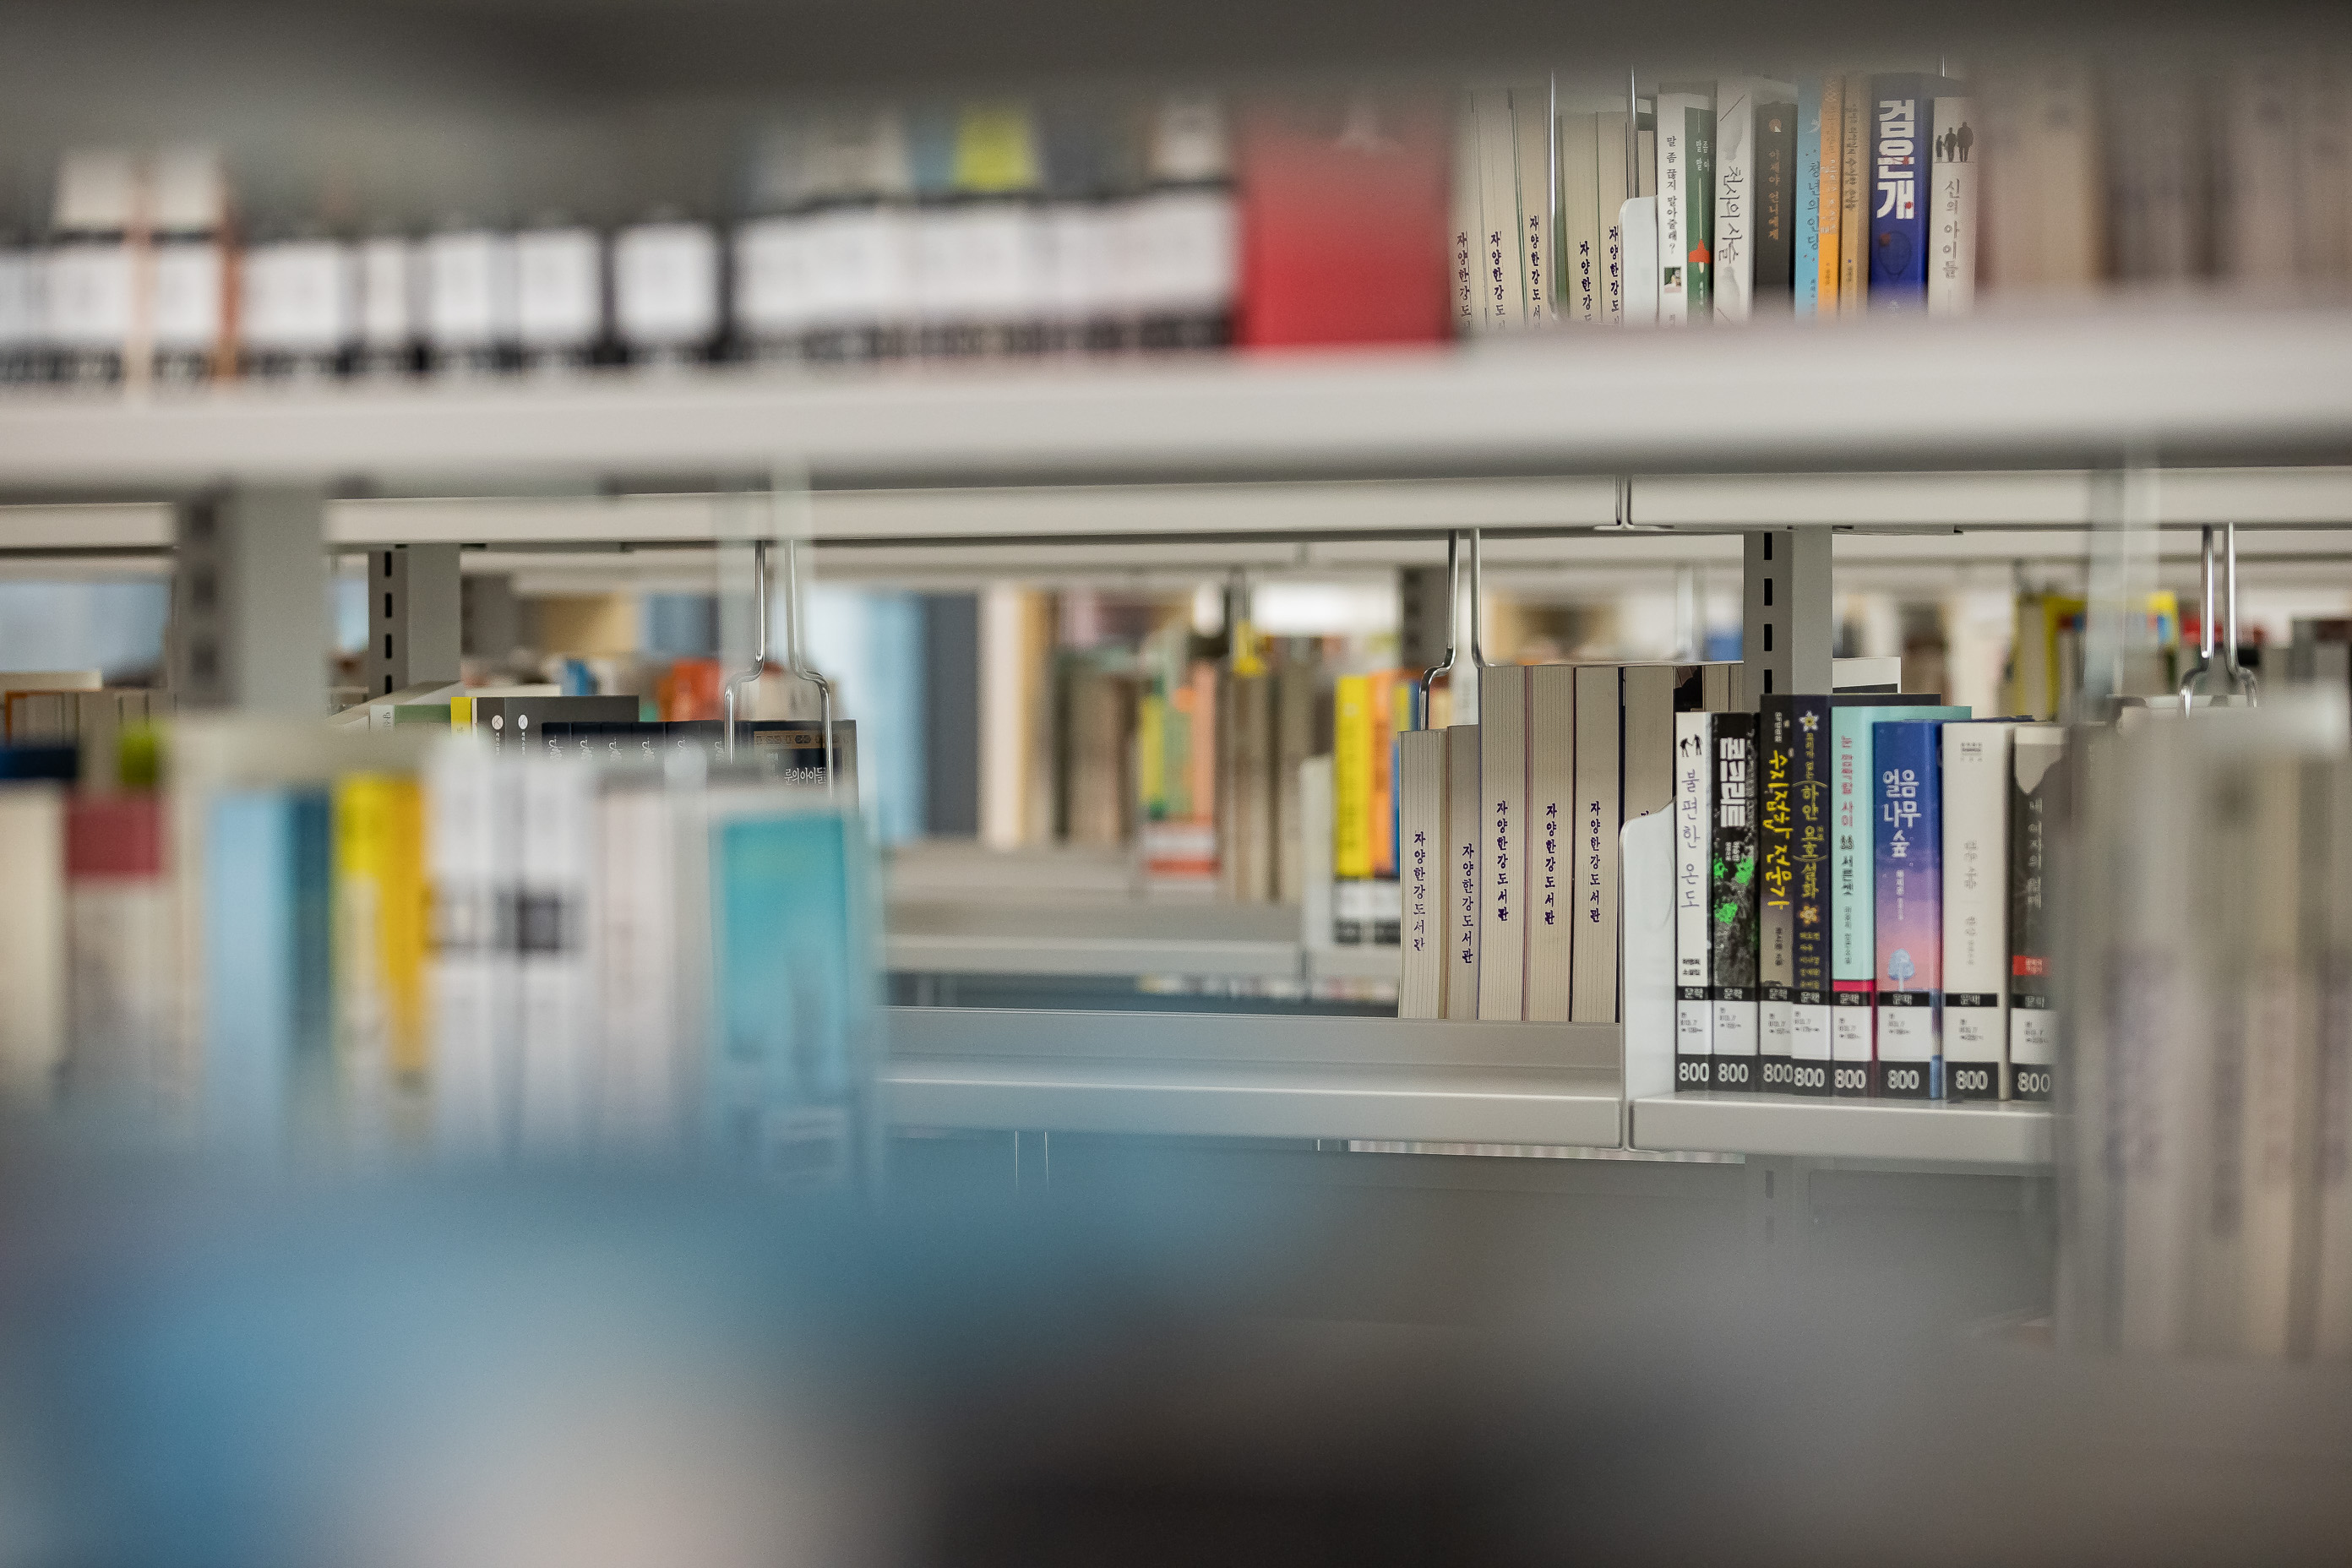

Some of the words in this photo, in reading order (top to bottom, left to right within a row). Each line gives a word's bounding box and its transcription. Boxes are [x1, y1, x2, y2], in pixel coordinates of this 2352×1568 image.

[1667, 136, 1677, 147] 말
[1667, 152, 1677, 163] 좀
[1719, 166, 1744, 218] 천사의
[1945, 177, 1960, 215] 신의
[1718, 223, 1743, 264] 사슬
[1943, 220, 1958, 279] 아이들
[1530, 215, 1541, 326] 자양한강도서
[1720, 738, 1745, 827] 콘크리트
[1762, 750, 1794, 840] 수지접합
[1883, 769, 1919, 798] 얼음
[1882, 801, 1922, 828] 나무
[1497, 800, 1509, 922] 자양한강도서관
[1590, 801, 1601, 923] 자양한강도서관
[1889, 830, 1911, 858] 숲
[1544, 803, 1557, 925] 자양한강도서관
[1765, 845, 1793, 910] 전문가
[1413, 830, 1426, 951] 자양한강도서관
[1462, 843, 1474, 963] 자양한강도서관
[1680, 863, 1700, 907] 온도
[1679, 1062, 1710, 1082] 800
[1718, 1063, 1749, 1082] 800
[1763, 1063, 1794, 1082] 800
[1794, 1067, 1825, 1087] 800
[1834, 1069, 1866, 1089] 800
[1887, 1070, 1919, 1090] 800
[1955, 1070, 1988, 1090] 800
[2017, 1072, 2050, 1092] 800
